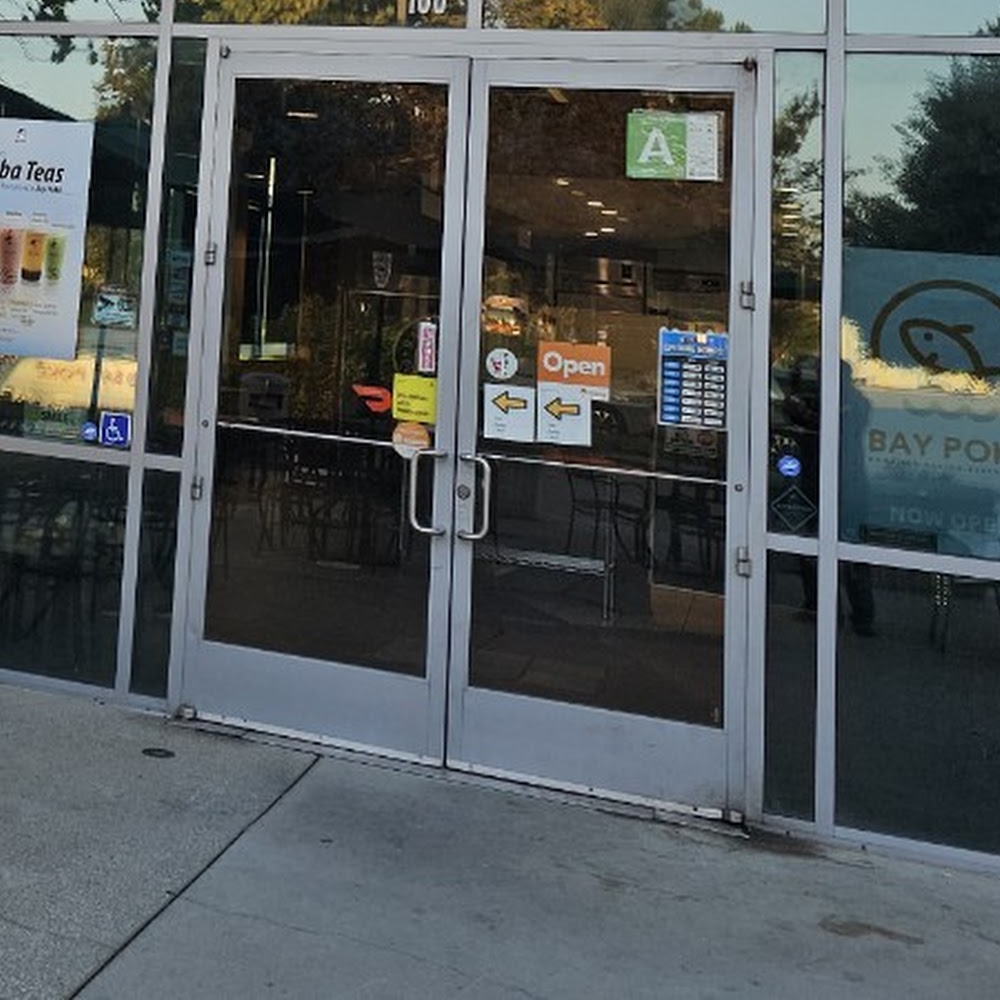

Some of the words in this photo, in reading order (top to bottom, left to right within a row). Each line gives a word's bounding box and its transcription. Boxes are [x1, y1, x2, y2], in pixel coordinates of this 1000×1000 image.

[636, 127, 675, 166] A
[26, 161, 65, 184] Teas
[543, 351, 606, 379] Open
[868, 428, 933, 456] BAY
[889, 505, 943, 528] NOW
[950, 511, 1000, 534] OPE
